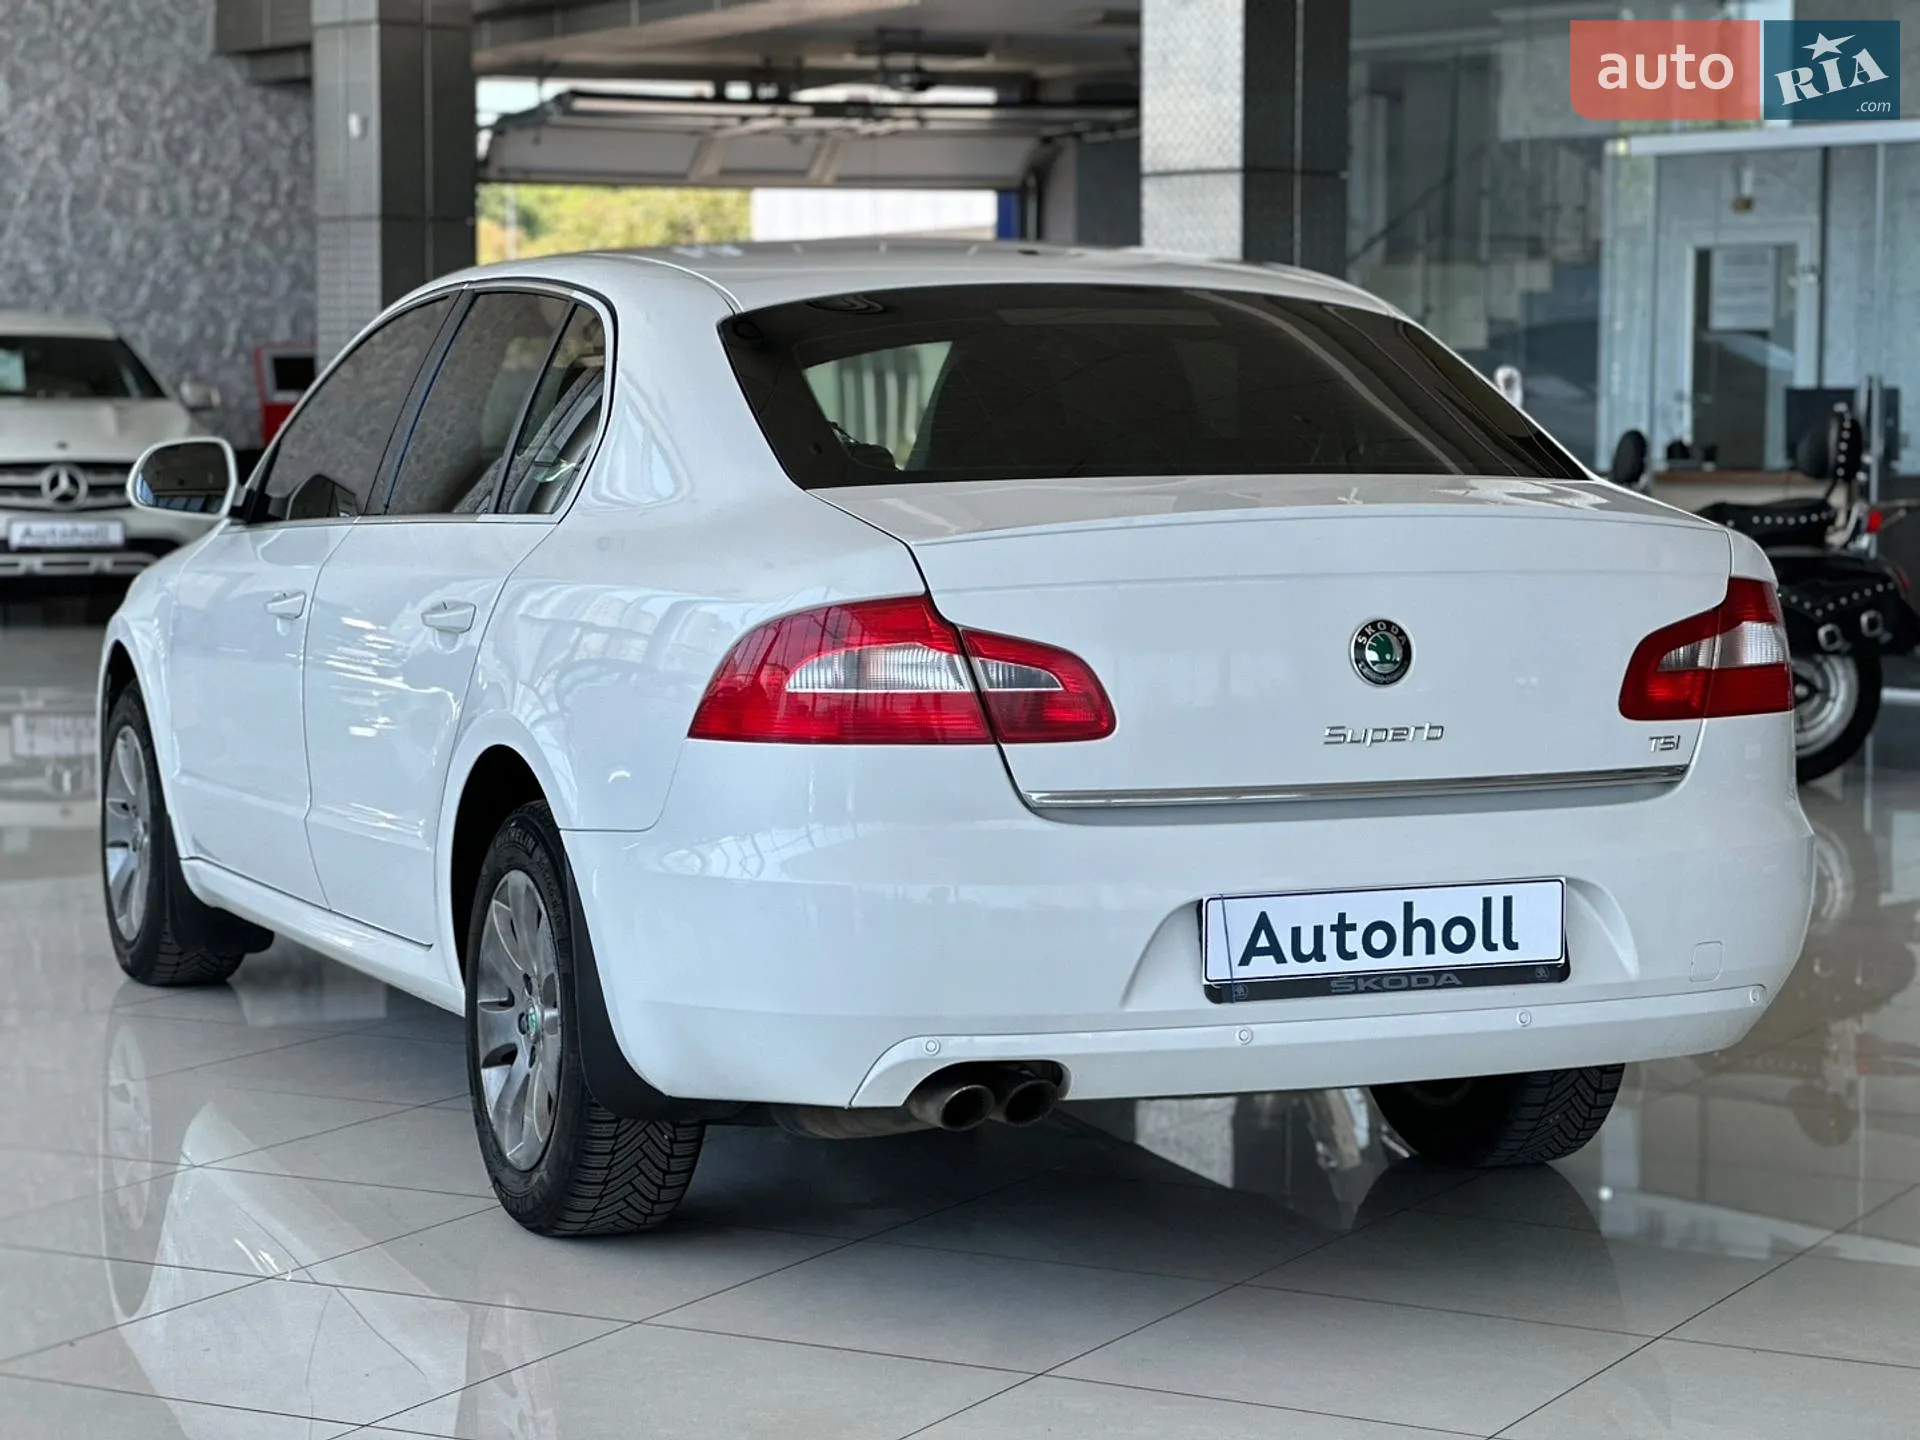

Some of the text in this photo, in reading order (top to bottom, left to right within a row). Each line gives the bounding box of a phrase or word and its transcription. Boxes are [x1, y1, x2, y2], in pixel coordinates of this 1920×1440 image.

[1323, 722, 1445, 748] Superb
[1648, 735, 1681, 752] TSI
[1238, 895, 1519, 967] Autoholl
